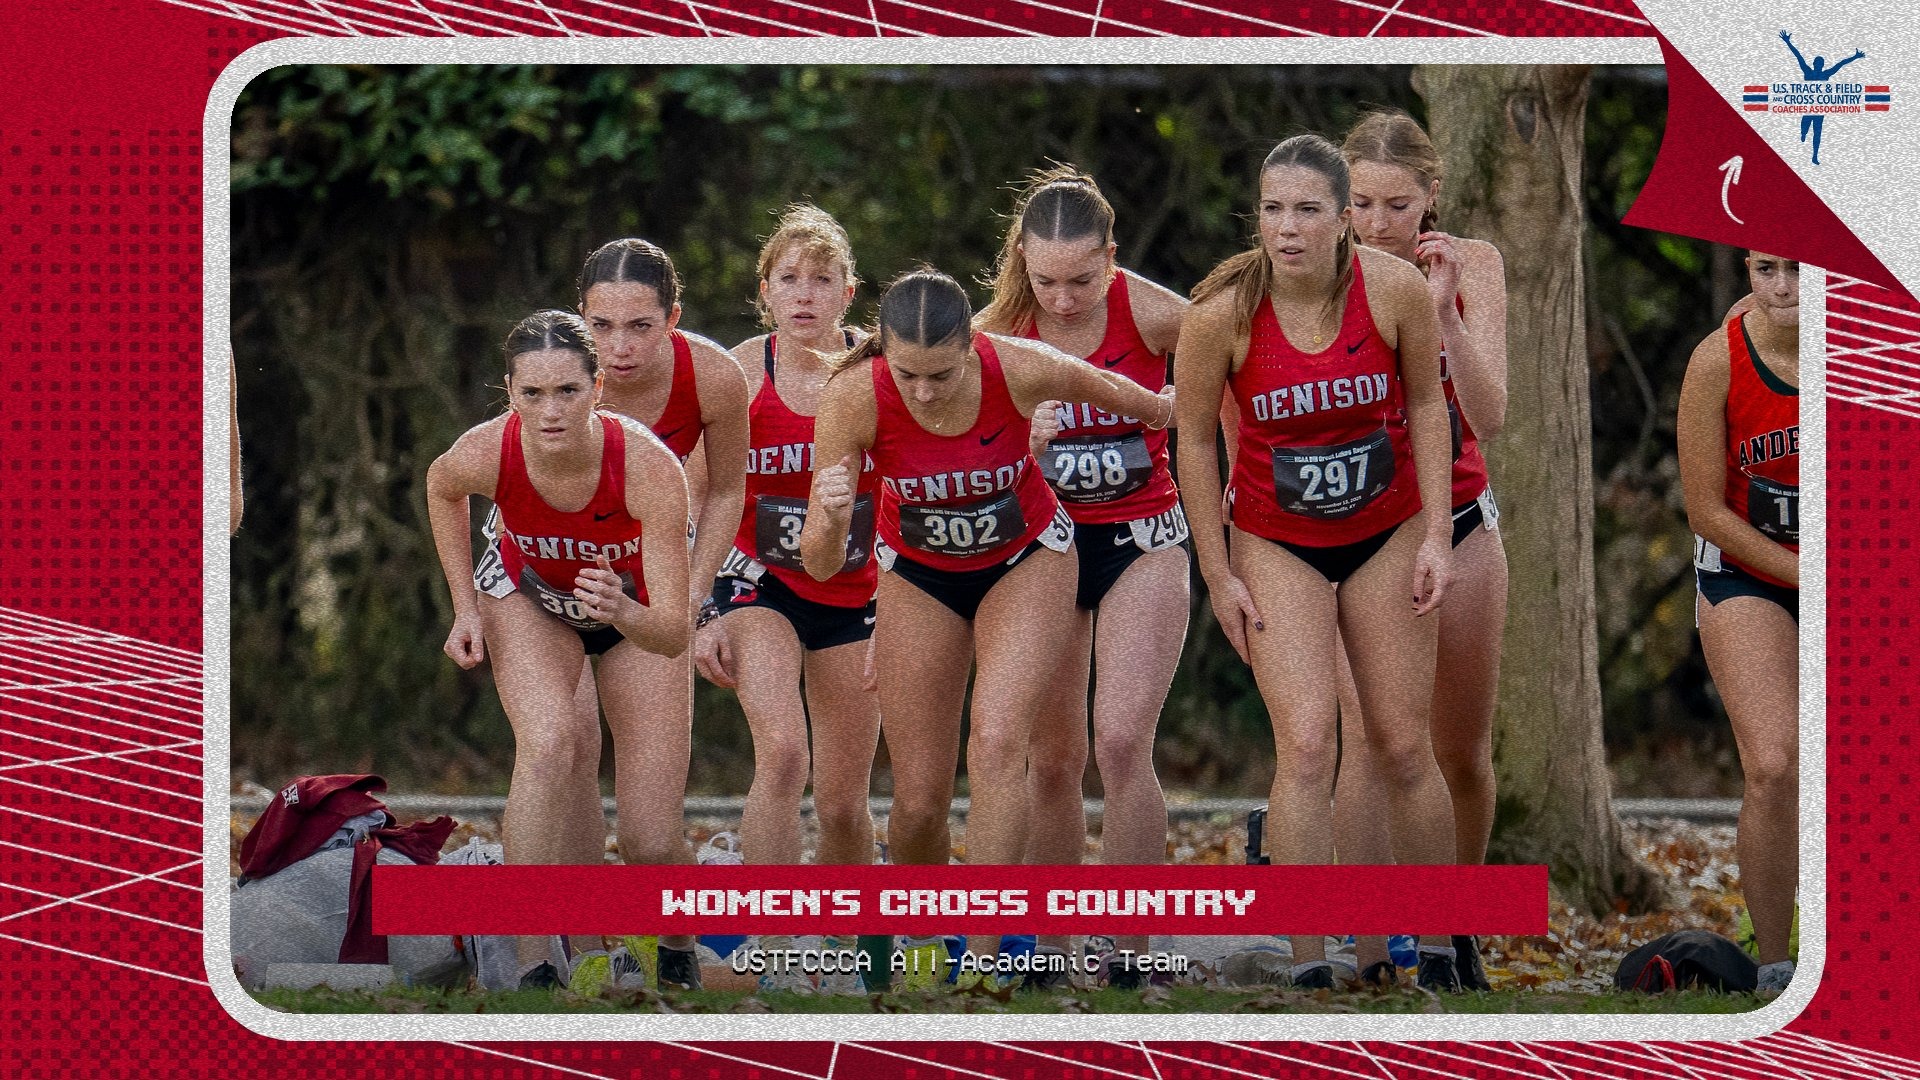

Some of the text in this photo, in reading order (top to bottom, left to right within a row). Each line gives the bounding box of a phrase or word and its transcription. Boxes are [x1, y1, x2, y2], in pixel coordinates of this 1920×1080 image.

[1252, 373, 1388, 421] DENISON
[1055, 449, 1127, 490] 298
[1300, 453, 1369, 501] 297
[924, 515, 1000, 548] 302
[1145, 503, 1186, 548] 298
[1773, 497, 1799, 526] 1
[475, 549, 508, 592] 03
[540, 592, 589, 620] 30
